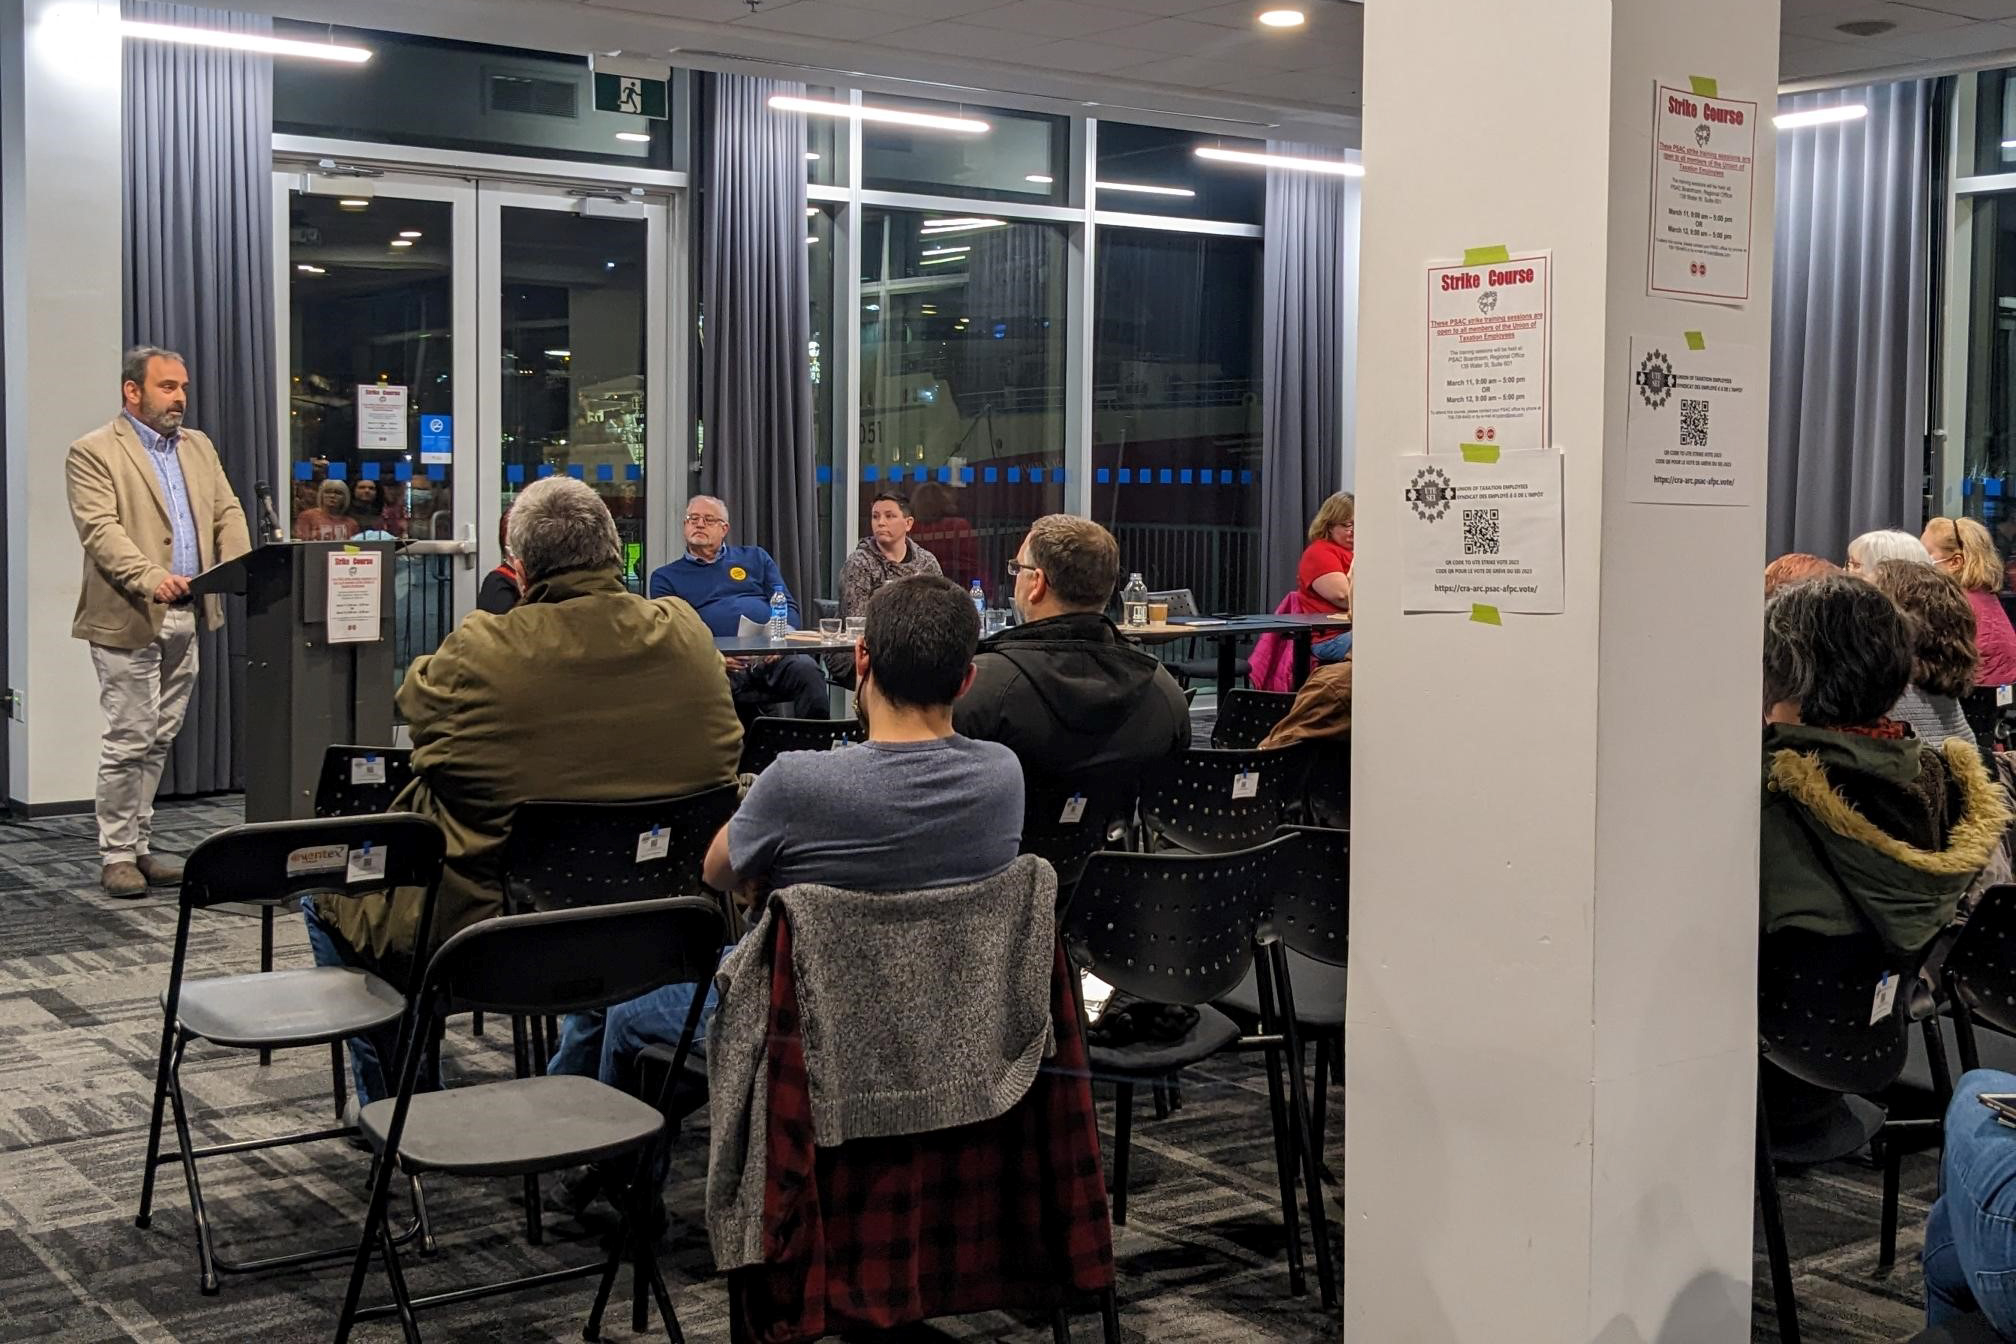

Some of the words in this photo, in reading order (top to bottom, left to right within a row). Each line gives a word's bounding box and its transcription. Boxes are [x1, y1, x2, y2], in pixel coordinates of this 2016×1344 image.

[1668, 96, 1697, 118] Strike
[1704, 103, 1744, 126] Course
[1668, 208, 1682, 216] March
[1442, 273, 1480, 291] Strike
[1489, 268, 1534, 287] Course
[1654, 475, 1735, 487] https://cra-arc.psac-afpc.vote/
[1434, 584, 1538, 594] https://cra-arc.psac-afpc.vote/
